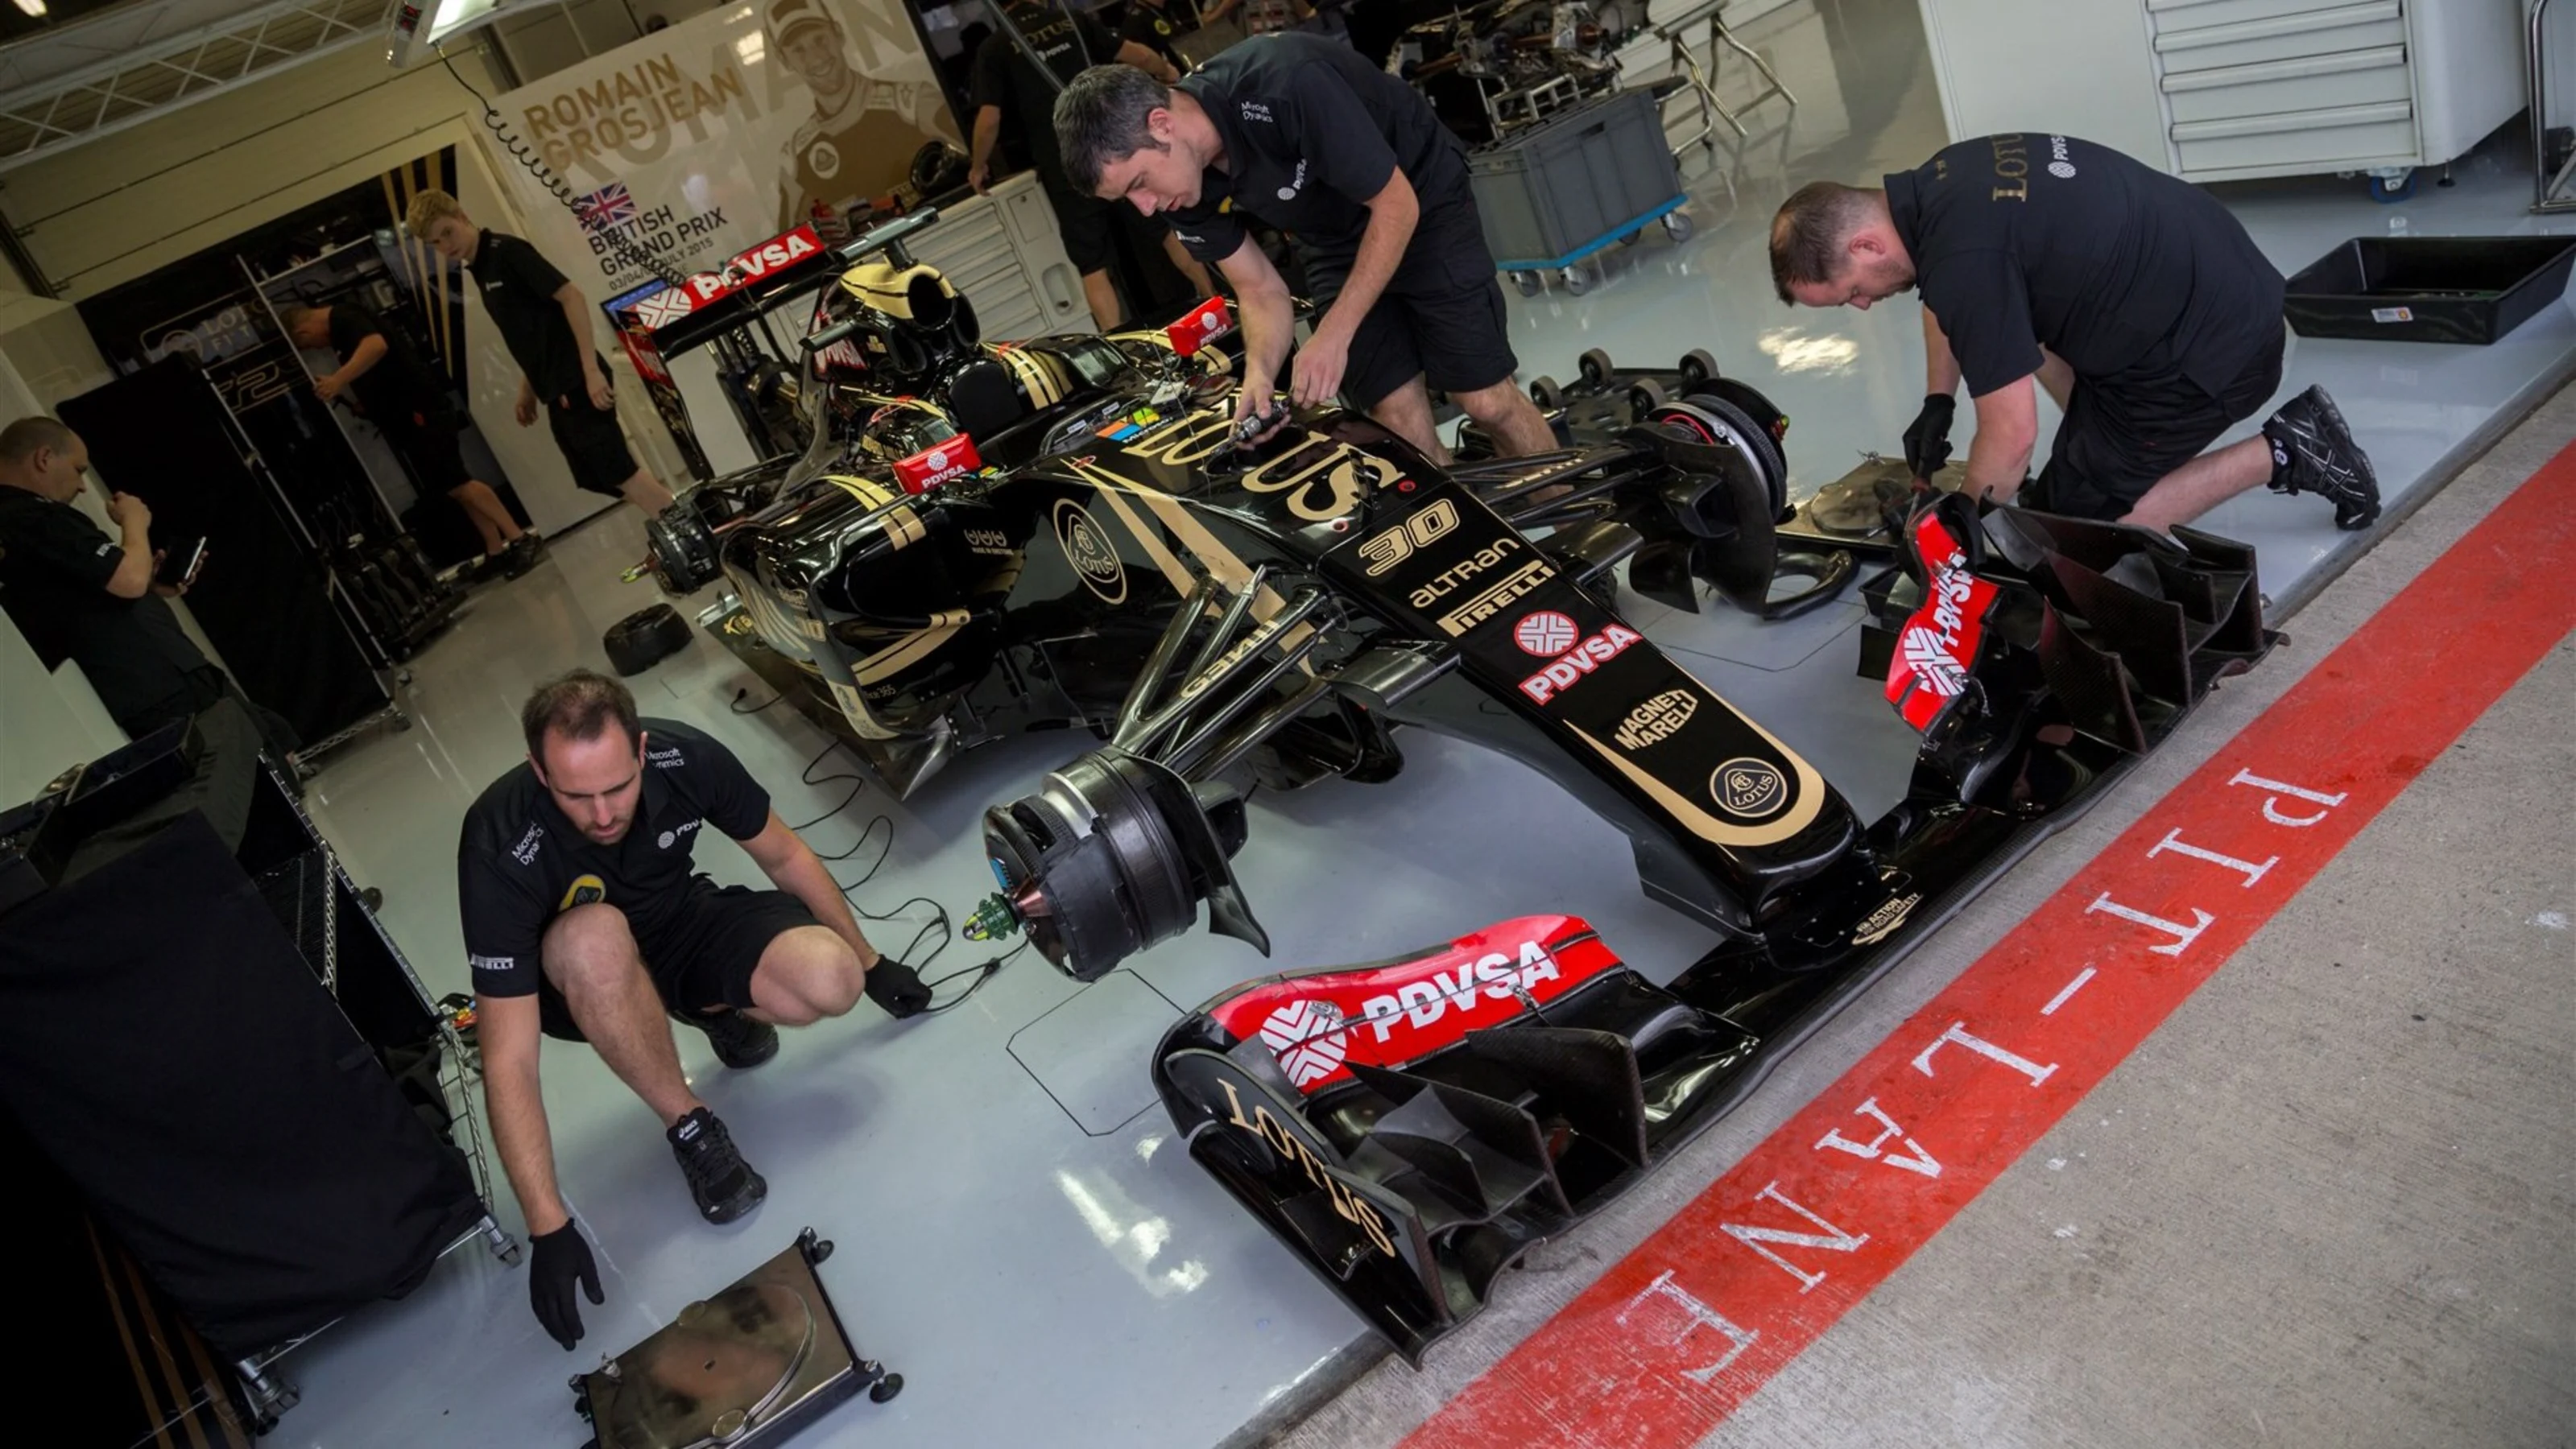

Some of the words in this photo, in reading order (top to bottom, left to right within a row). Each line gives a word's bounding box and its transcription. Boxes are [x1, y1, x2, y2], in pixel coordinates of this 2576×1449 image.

[523, 52, 681, 140] ROMAIN
[543, 67, 745, 170] GROSJEAN
[1989, 133, 2028, 202] LOTU
[675, 205, 728, 243] PRIX
[686, 236, 714, 257] 2015
[921, 464, 967, 489] PDVSA
[1073, 547, 1115, 575] LOTUS
[1358, 498, 1460, 576] 30
[1437, 559, 1556, 638] PIRELLI
[1520, 624, 1641, 704] PDVSA
[1733, 774, 1774, 806] LOTUS
[1362, 939, 1560, 1043] PDVSA
[1217, 1077, 1396, 1258] LOTUS
